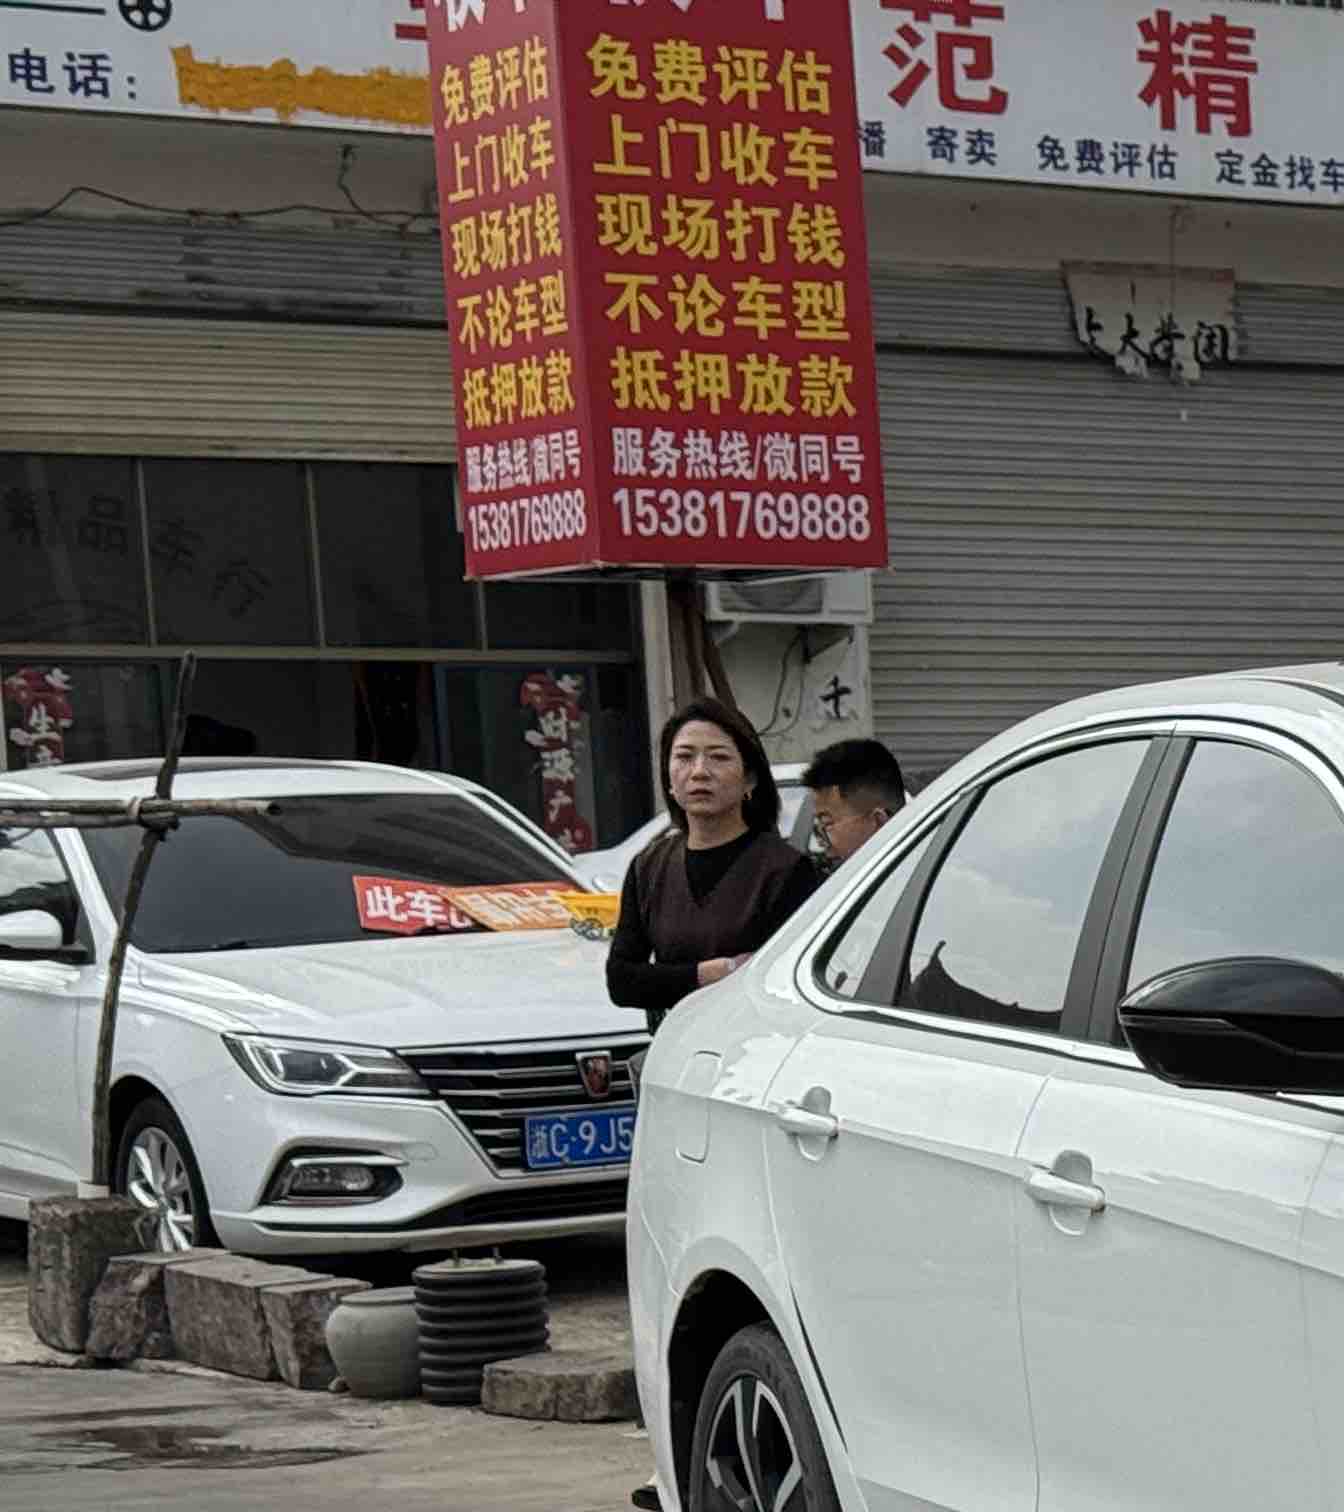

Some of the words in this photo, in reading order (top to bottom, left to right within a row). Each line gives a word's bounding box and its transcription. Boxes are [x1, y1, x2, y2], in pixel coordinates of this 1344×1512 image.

[441, 36, 548, 128] 免费评估
[587, 33, 833, 114] 免费评估
[449, 116, 555, 203] 上门收车
[593, 113, 838, 190] 上门收车
[926, 126, 997, 166] 寄卖
[1037, 135, 1178, 180] 免费评估
[451, 192, 562, 279] 现场打钱
[597, 193, 845, 269] 现场打钱
[457, 271, 569, 354] 不论车型
[605, 272, 850, 342] 不论车型
[463, 349, 575, 430] 抵押放款
[610, 344, 856, 417] 抵押放款
[465, 429, 581, 493] 服务热线/微同号
[612, 427, 864, 483] 服务热线/微同号
[468, 488, 586, 552] 15381769888
[613, 488, 870, 541] 15381769888
